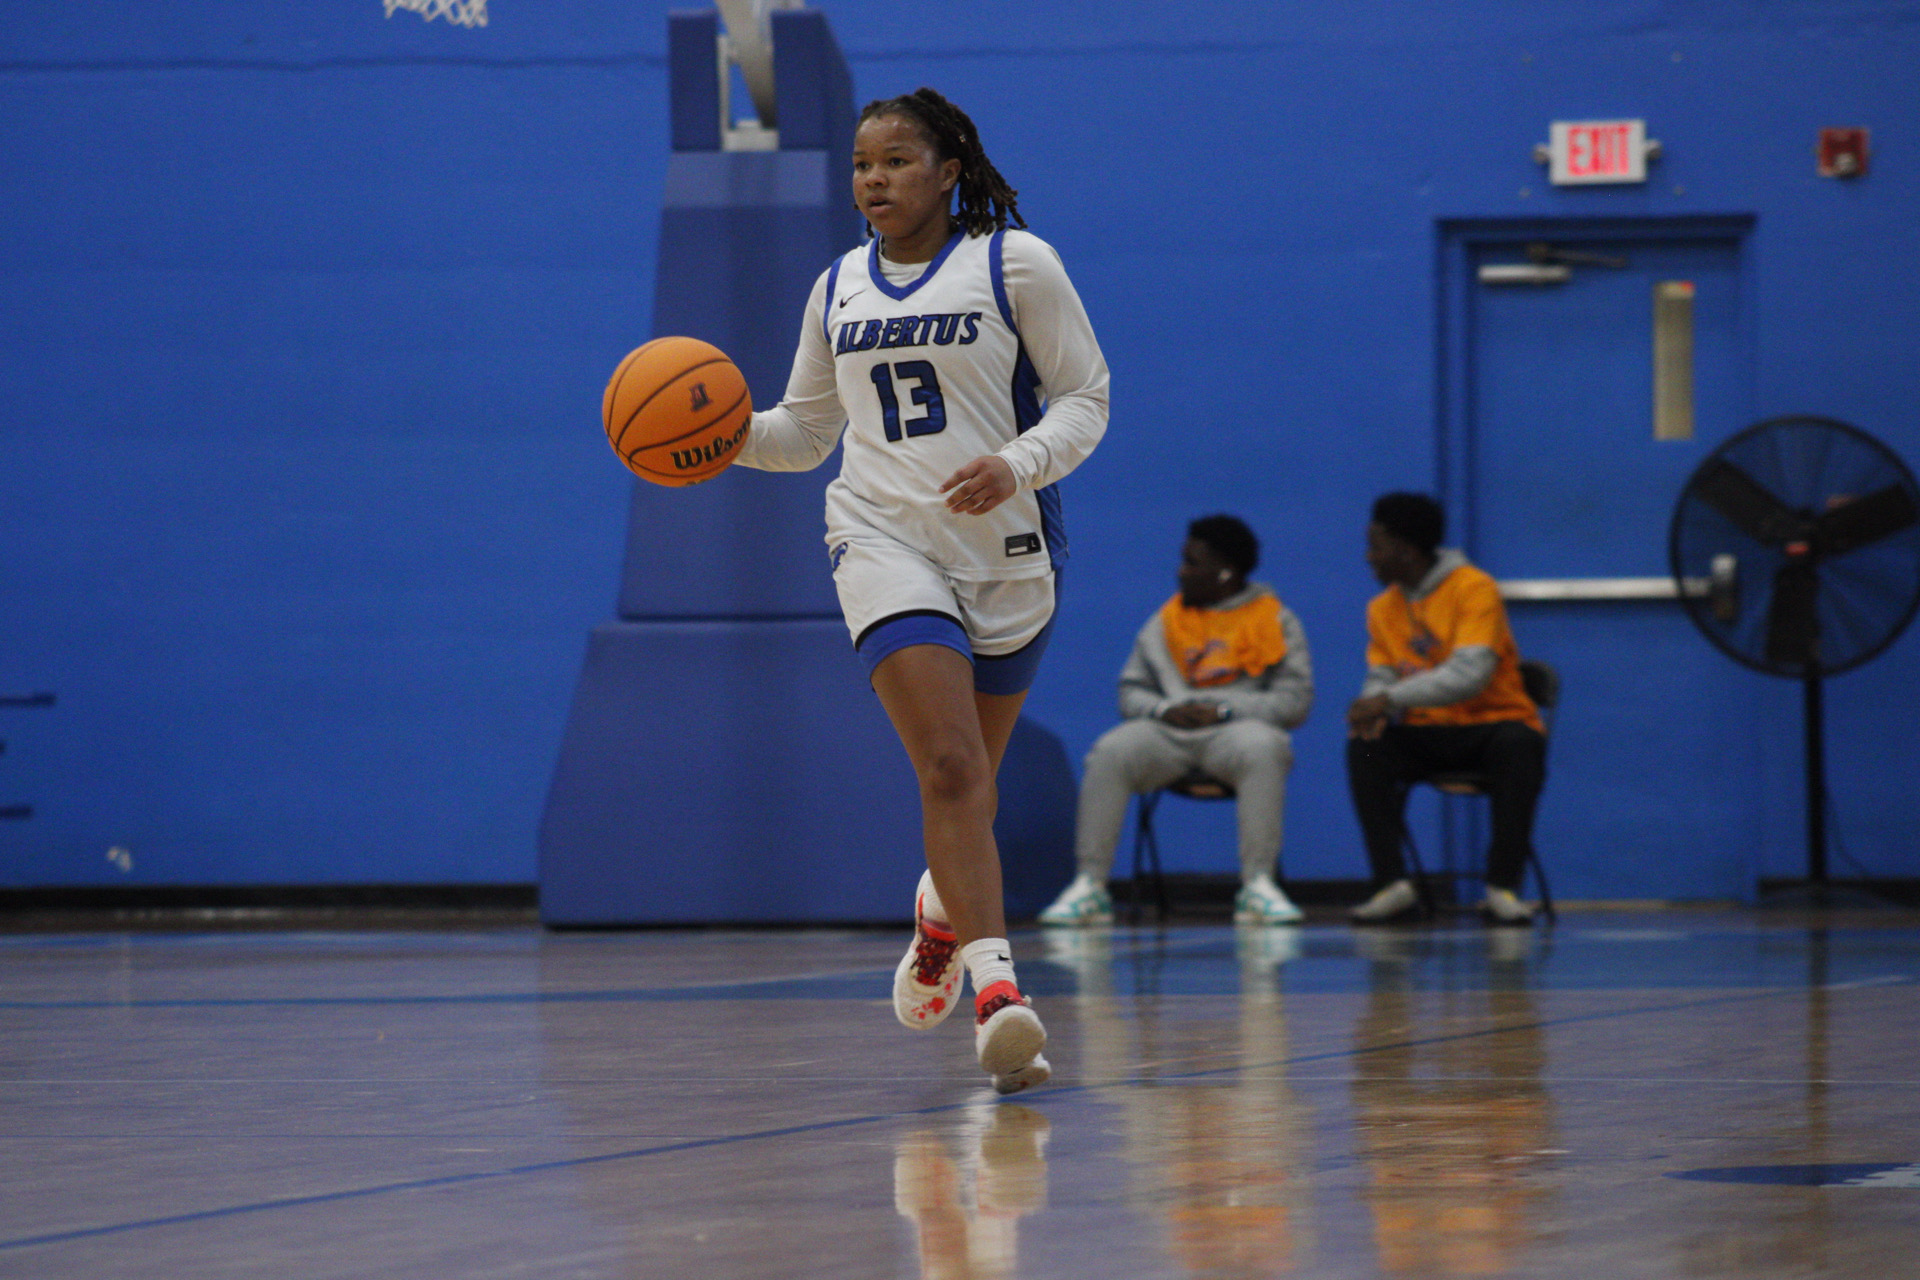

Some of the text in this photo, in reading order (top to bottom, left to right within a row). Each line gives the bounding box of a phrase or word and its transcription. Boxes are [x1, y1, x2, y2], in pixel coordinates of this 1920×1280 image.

[1567, 124, 1631, 176] EXIT
[835, 312, 982, 357] ALBERTUS
[870, 360, 947, 442] 13
